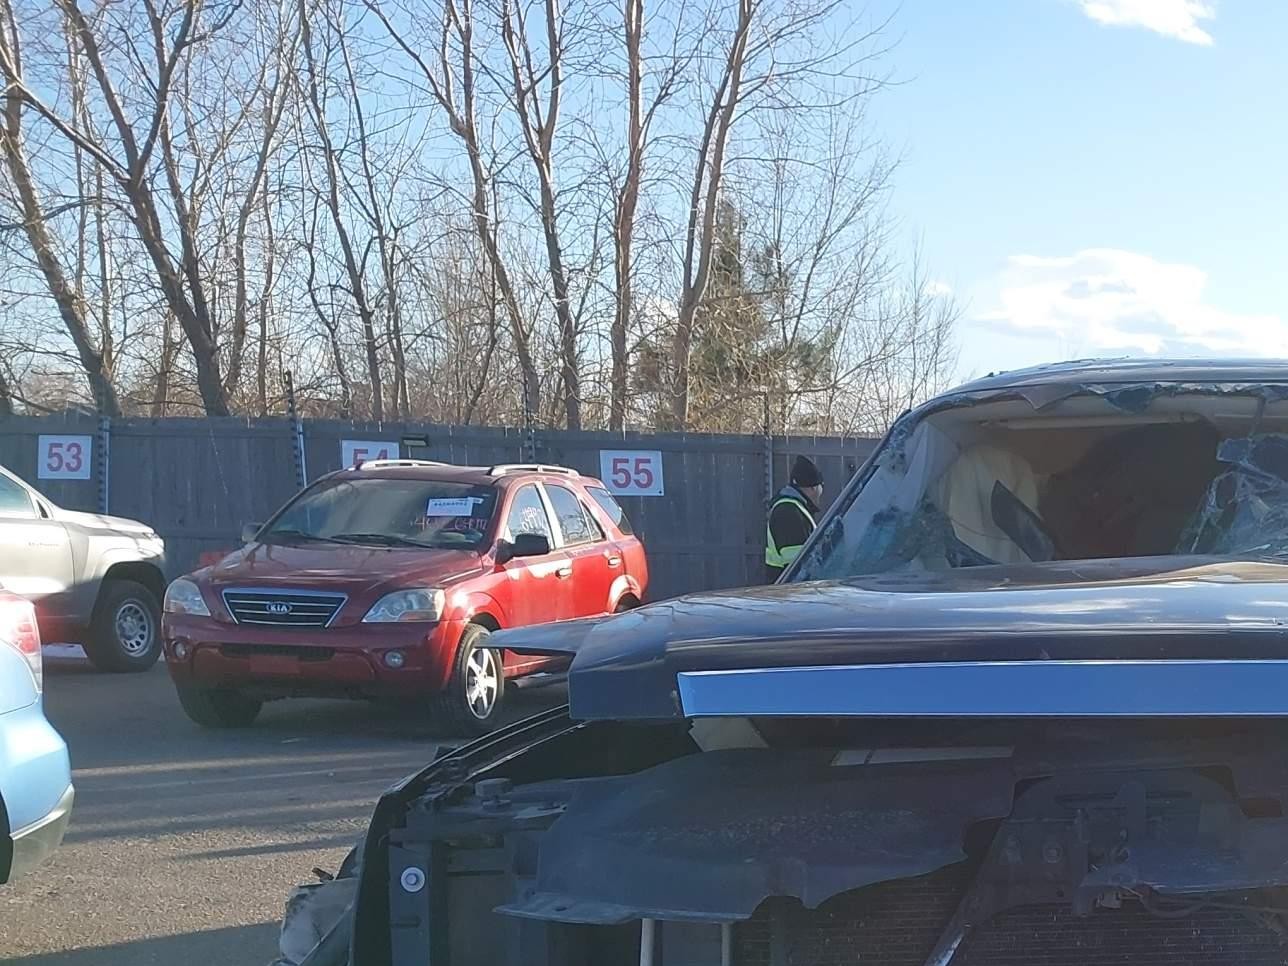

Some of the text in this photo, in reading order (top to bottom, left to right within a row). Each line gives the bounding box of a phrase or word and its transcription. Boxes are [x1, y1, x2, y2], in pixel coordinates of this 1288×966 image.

[47, 442, 83, 473] 53
[611, 457, 653, 489] 55
[269, 603, 289, 613] KIA
